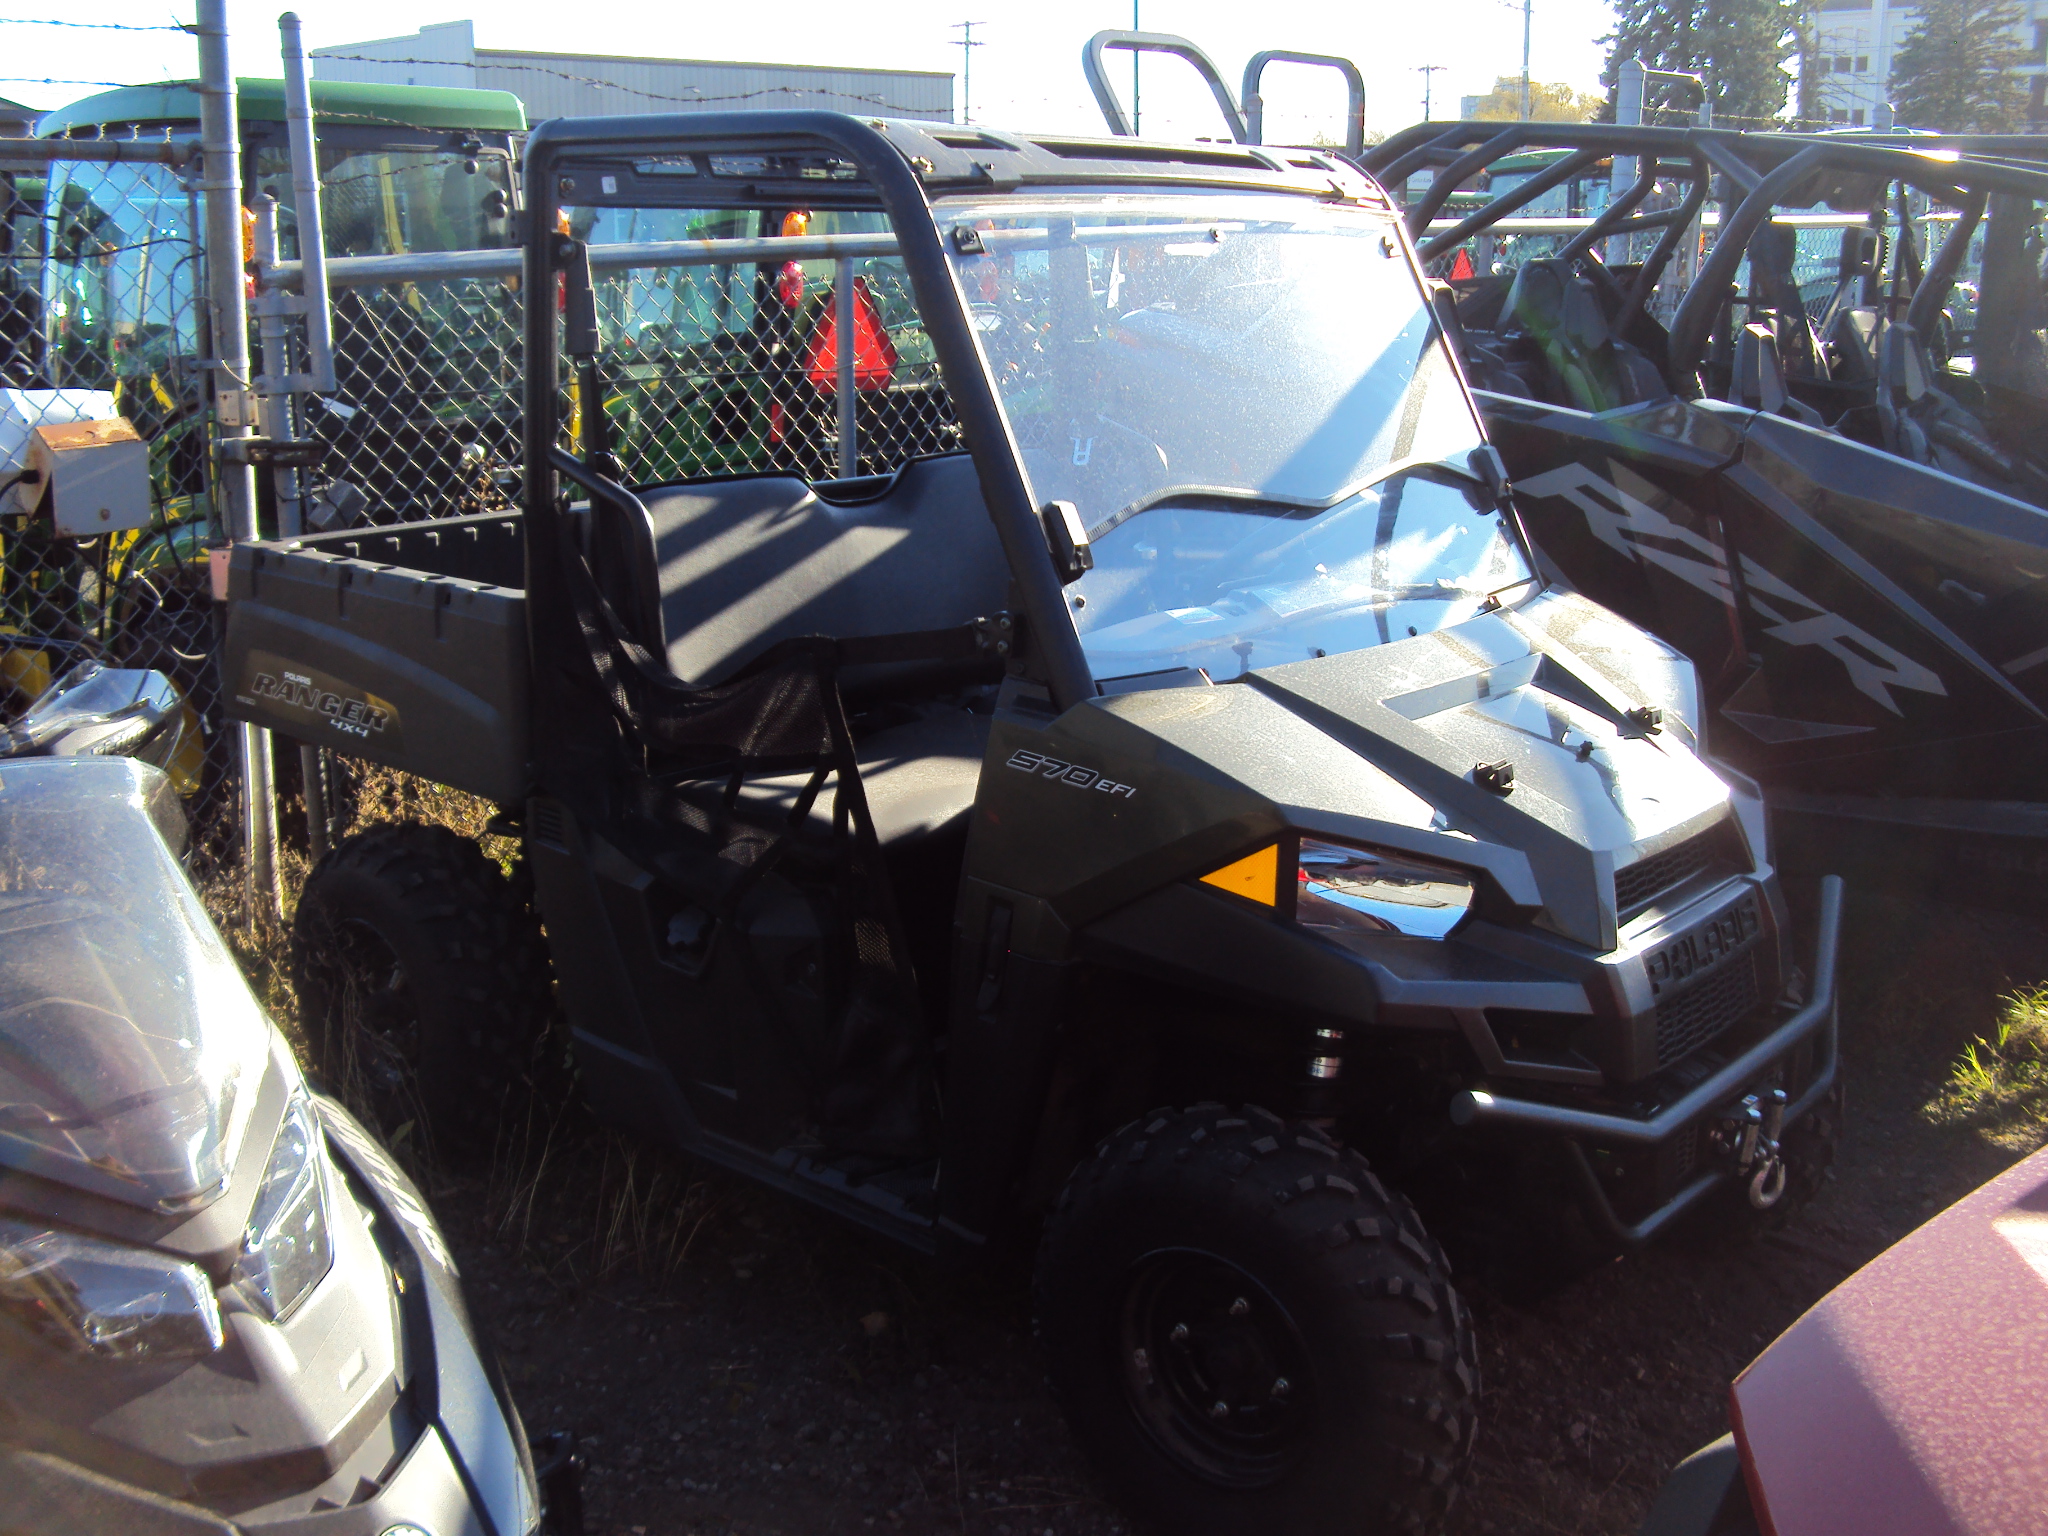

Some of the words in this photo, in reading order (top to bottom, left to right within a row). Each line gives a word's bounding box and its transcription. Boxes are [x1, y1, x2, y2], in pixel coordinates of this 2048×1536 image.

[1512, 458, 1948, 718] RZR
[252, 672, 390, 733] RANGER
[284, 671, 311, 685] POLARIS
[1006, 749, 1099, 789] 570
[1095, 779, 1136, 798] EFI
[1646, 898, 1758, 995] POLARIS
